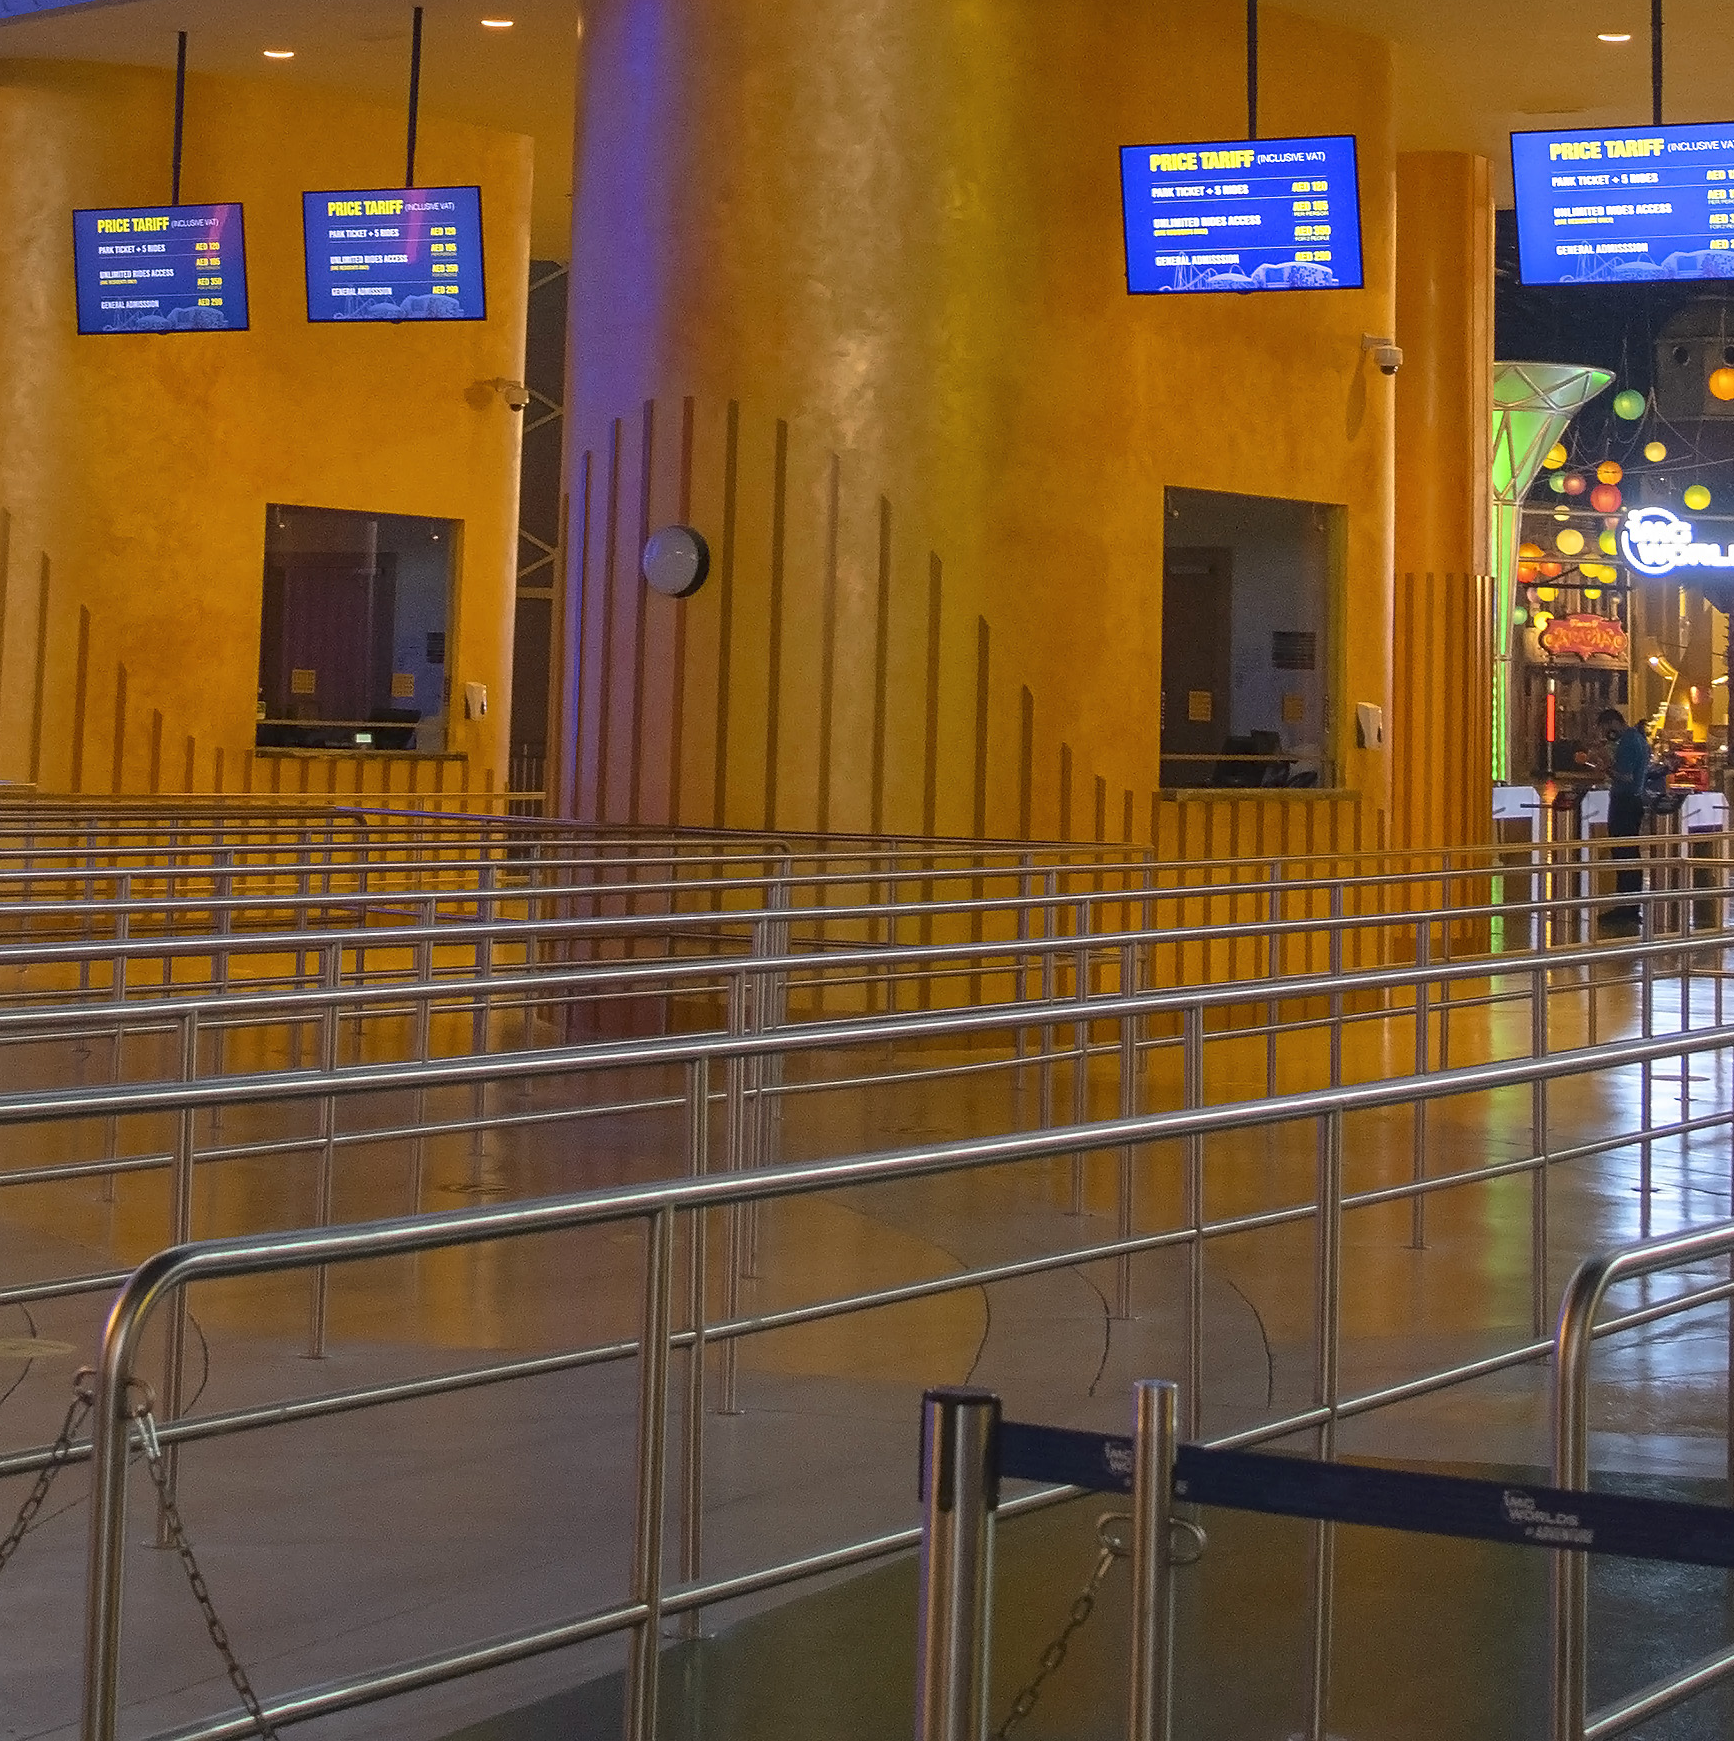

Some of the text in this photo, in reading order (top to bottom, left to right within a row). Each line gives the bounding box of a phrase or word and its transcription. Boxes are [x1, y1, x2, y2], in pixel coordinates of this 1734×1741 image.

[1550, 142, 1602, 160] PRICE
[1604, 138, 1664, 159] TARIFF
[1668, 141, 1719, 153] (INCLUSIVE
[1150, 150, 1325, 172] PRICE TARIFF (INCLUSIVE VAT)
[1578, 174, 1610, 186] TICKET
[328, 202, 362, 216] PRICE
[364, 200, 403, 215] TARIFF
[98, 219, 130, 233] PRICE
[132, 217, 169, 231] TARIFF
